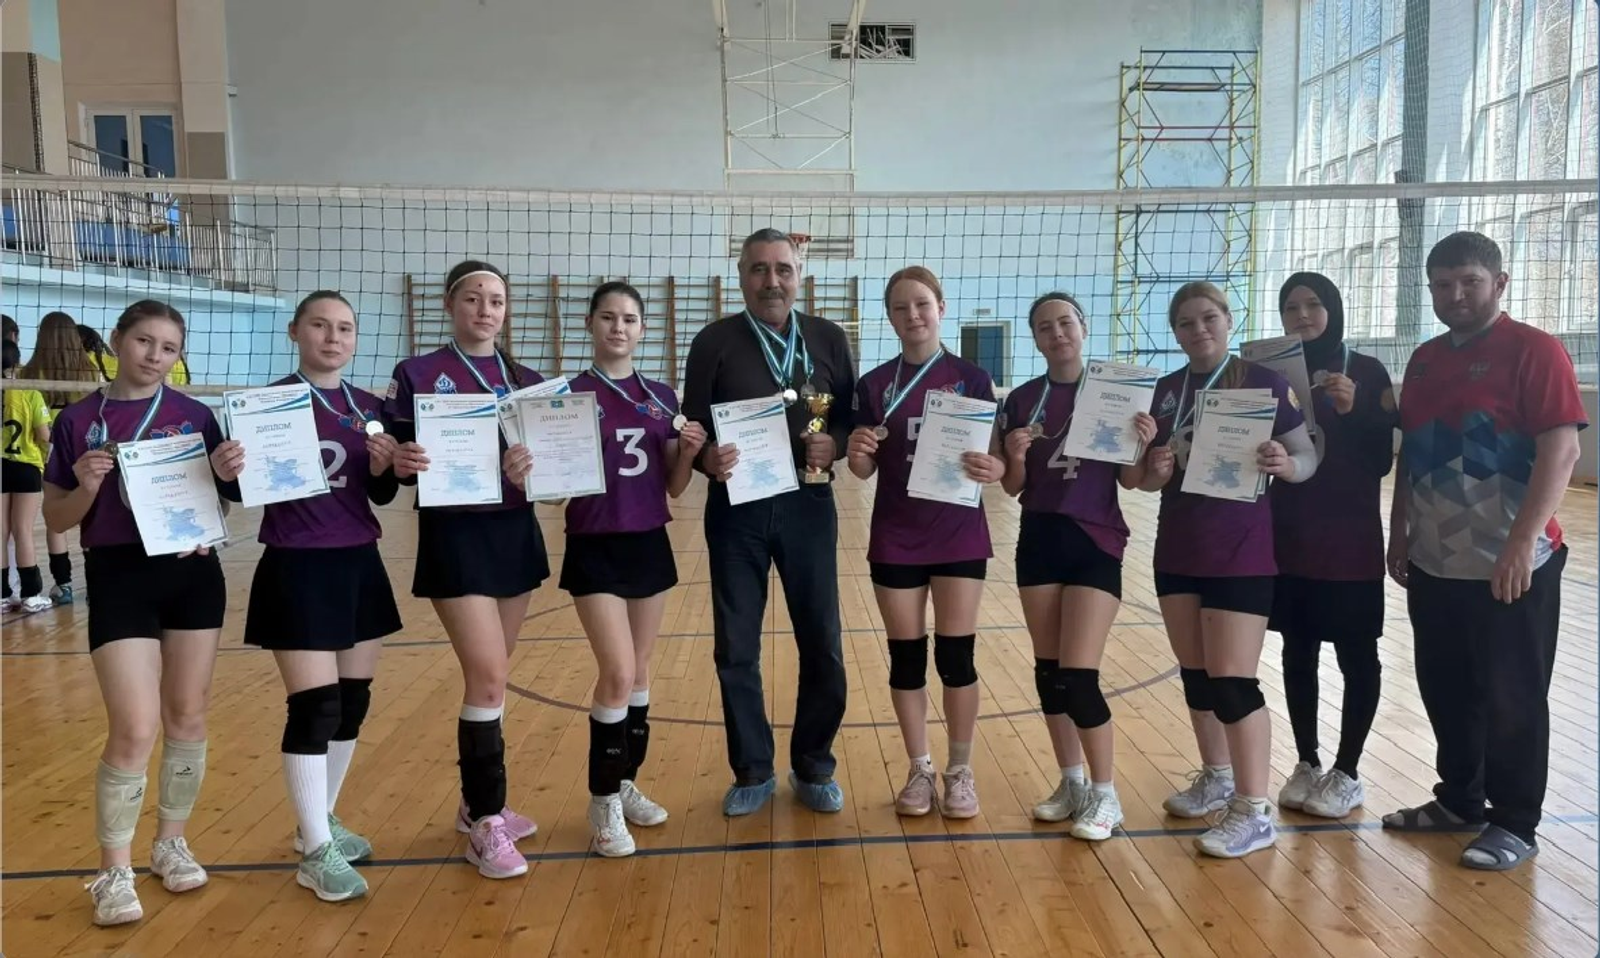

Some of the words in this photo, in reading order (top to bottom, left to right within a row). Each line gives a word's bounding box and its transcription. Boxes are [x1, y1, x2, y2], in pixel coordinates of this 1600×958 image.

[1099, 392, 1131, 403] ДИПЛОМ
[539, 413, 579, 423] ДИПЛОМ
[255, 422, 292, 434] ДИПЛОМ
[440, 429, 476, 437] ДИПЛОМ
[738, 427, 769, 439] ДИПЛОМ
[940, 426, 972, 437] ДИПЛОМ
[1217, 426, 1250, 435] ДИПЛОМ
[4, 419, 23, 454] 2
[615, 427, 649, 477] 3
[1047, 436, 1081, 480] 4
[318, 440, 348, 488] 2
[151, 471, 188, 485] ДИПЛОМ
